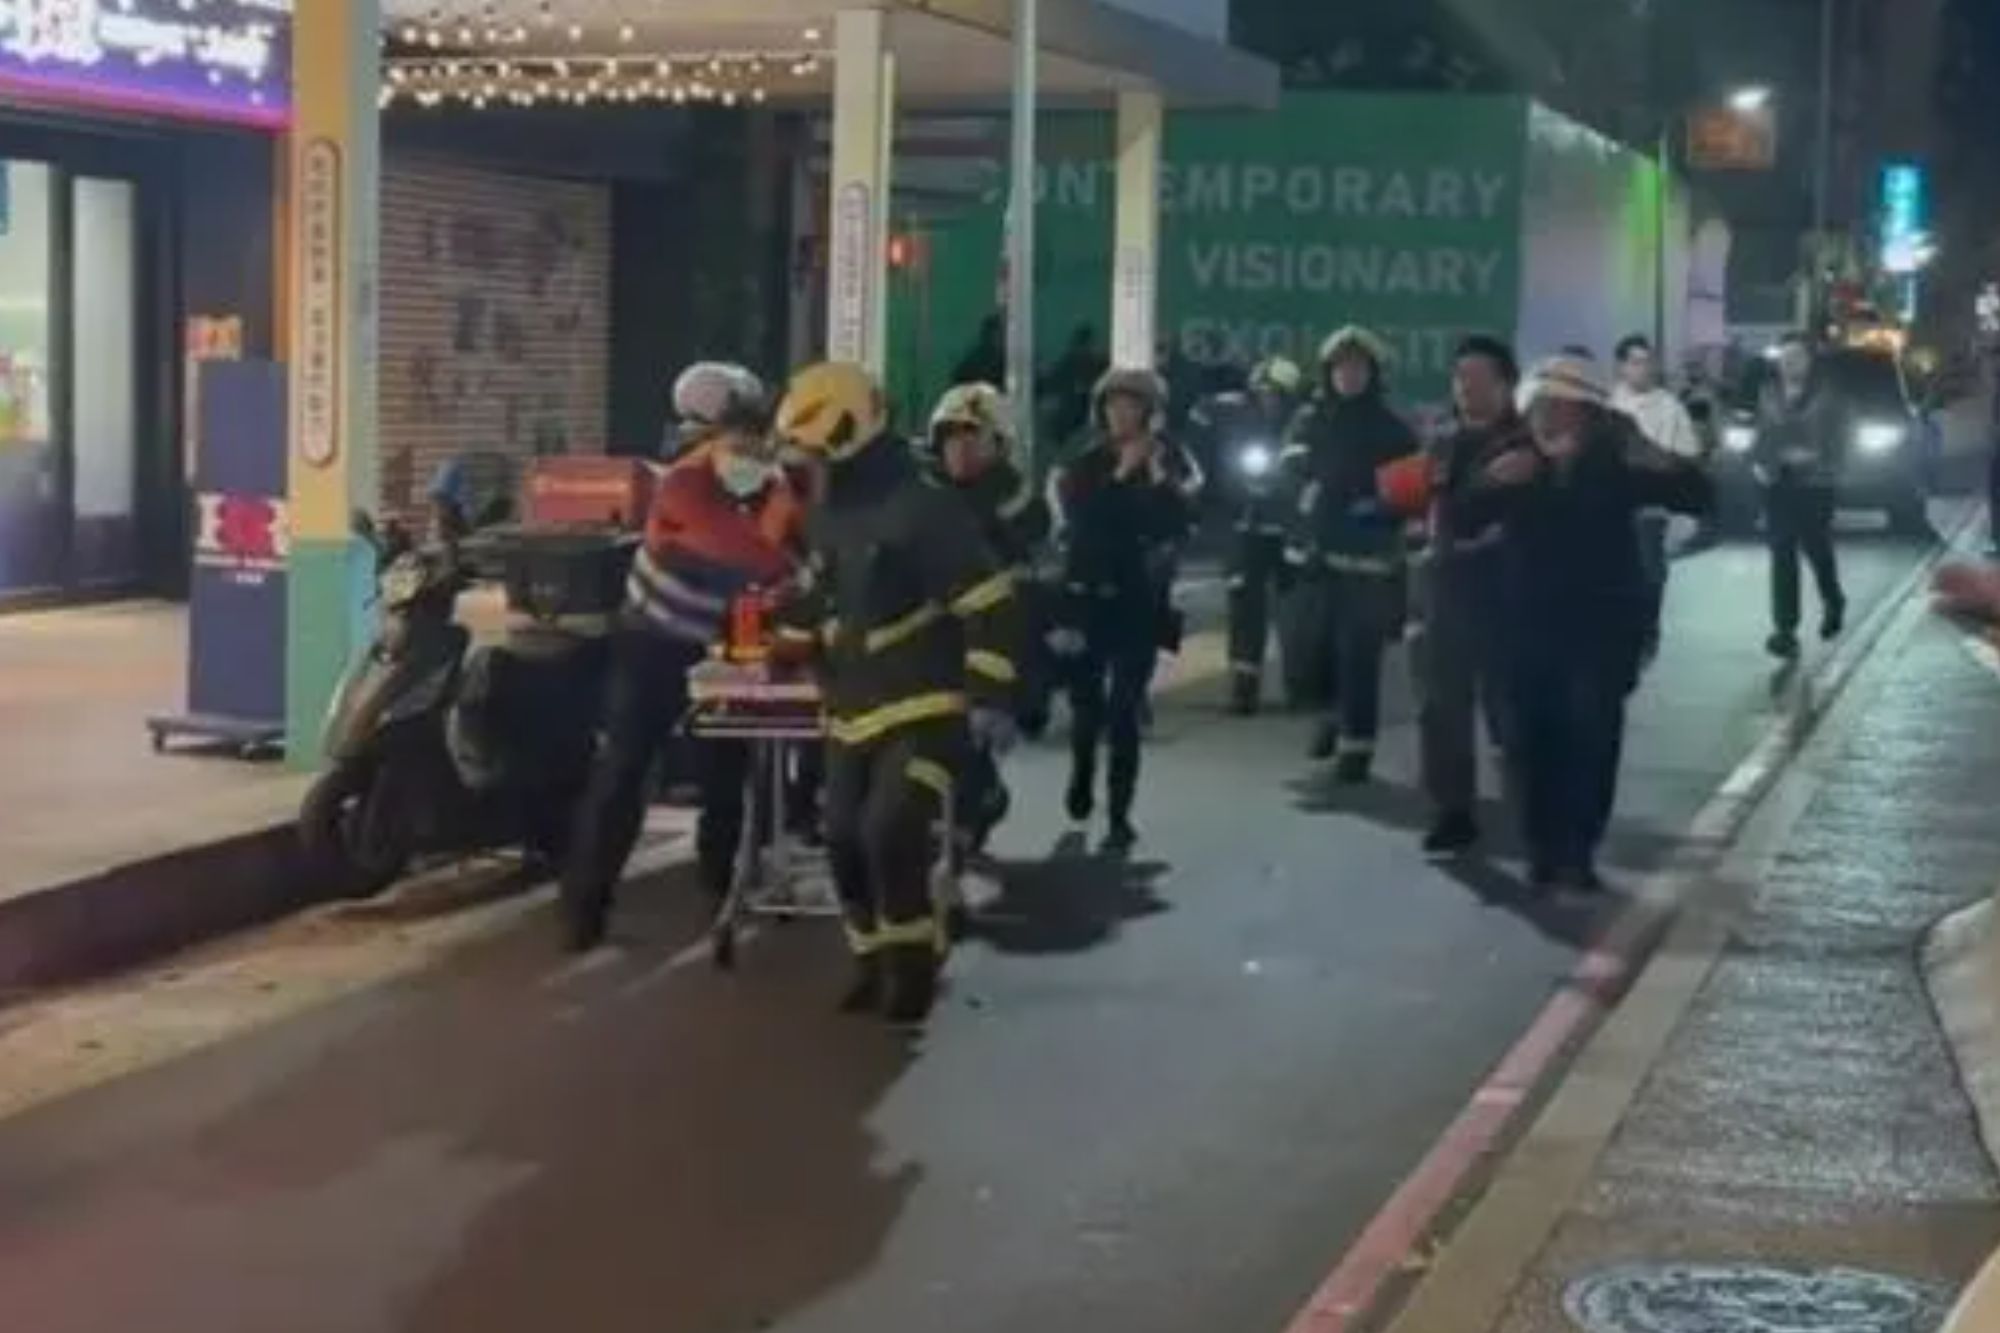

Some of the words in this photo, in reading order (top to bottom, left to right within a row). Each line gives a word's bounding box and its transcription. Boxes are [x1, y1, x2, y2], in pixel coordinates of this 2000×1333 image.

[977, 156, 1506, 220] NEMPORARY
[1186, 240, 1502, 296] VISIONARY
[1180, 317, 1500, 378] EXQIT
